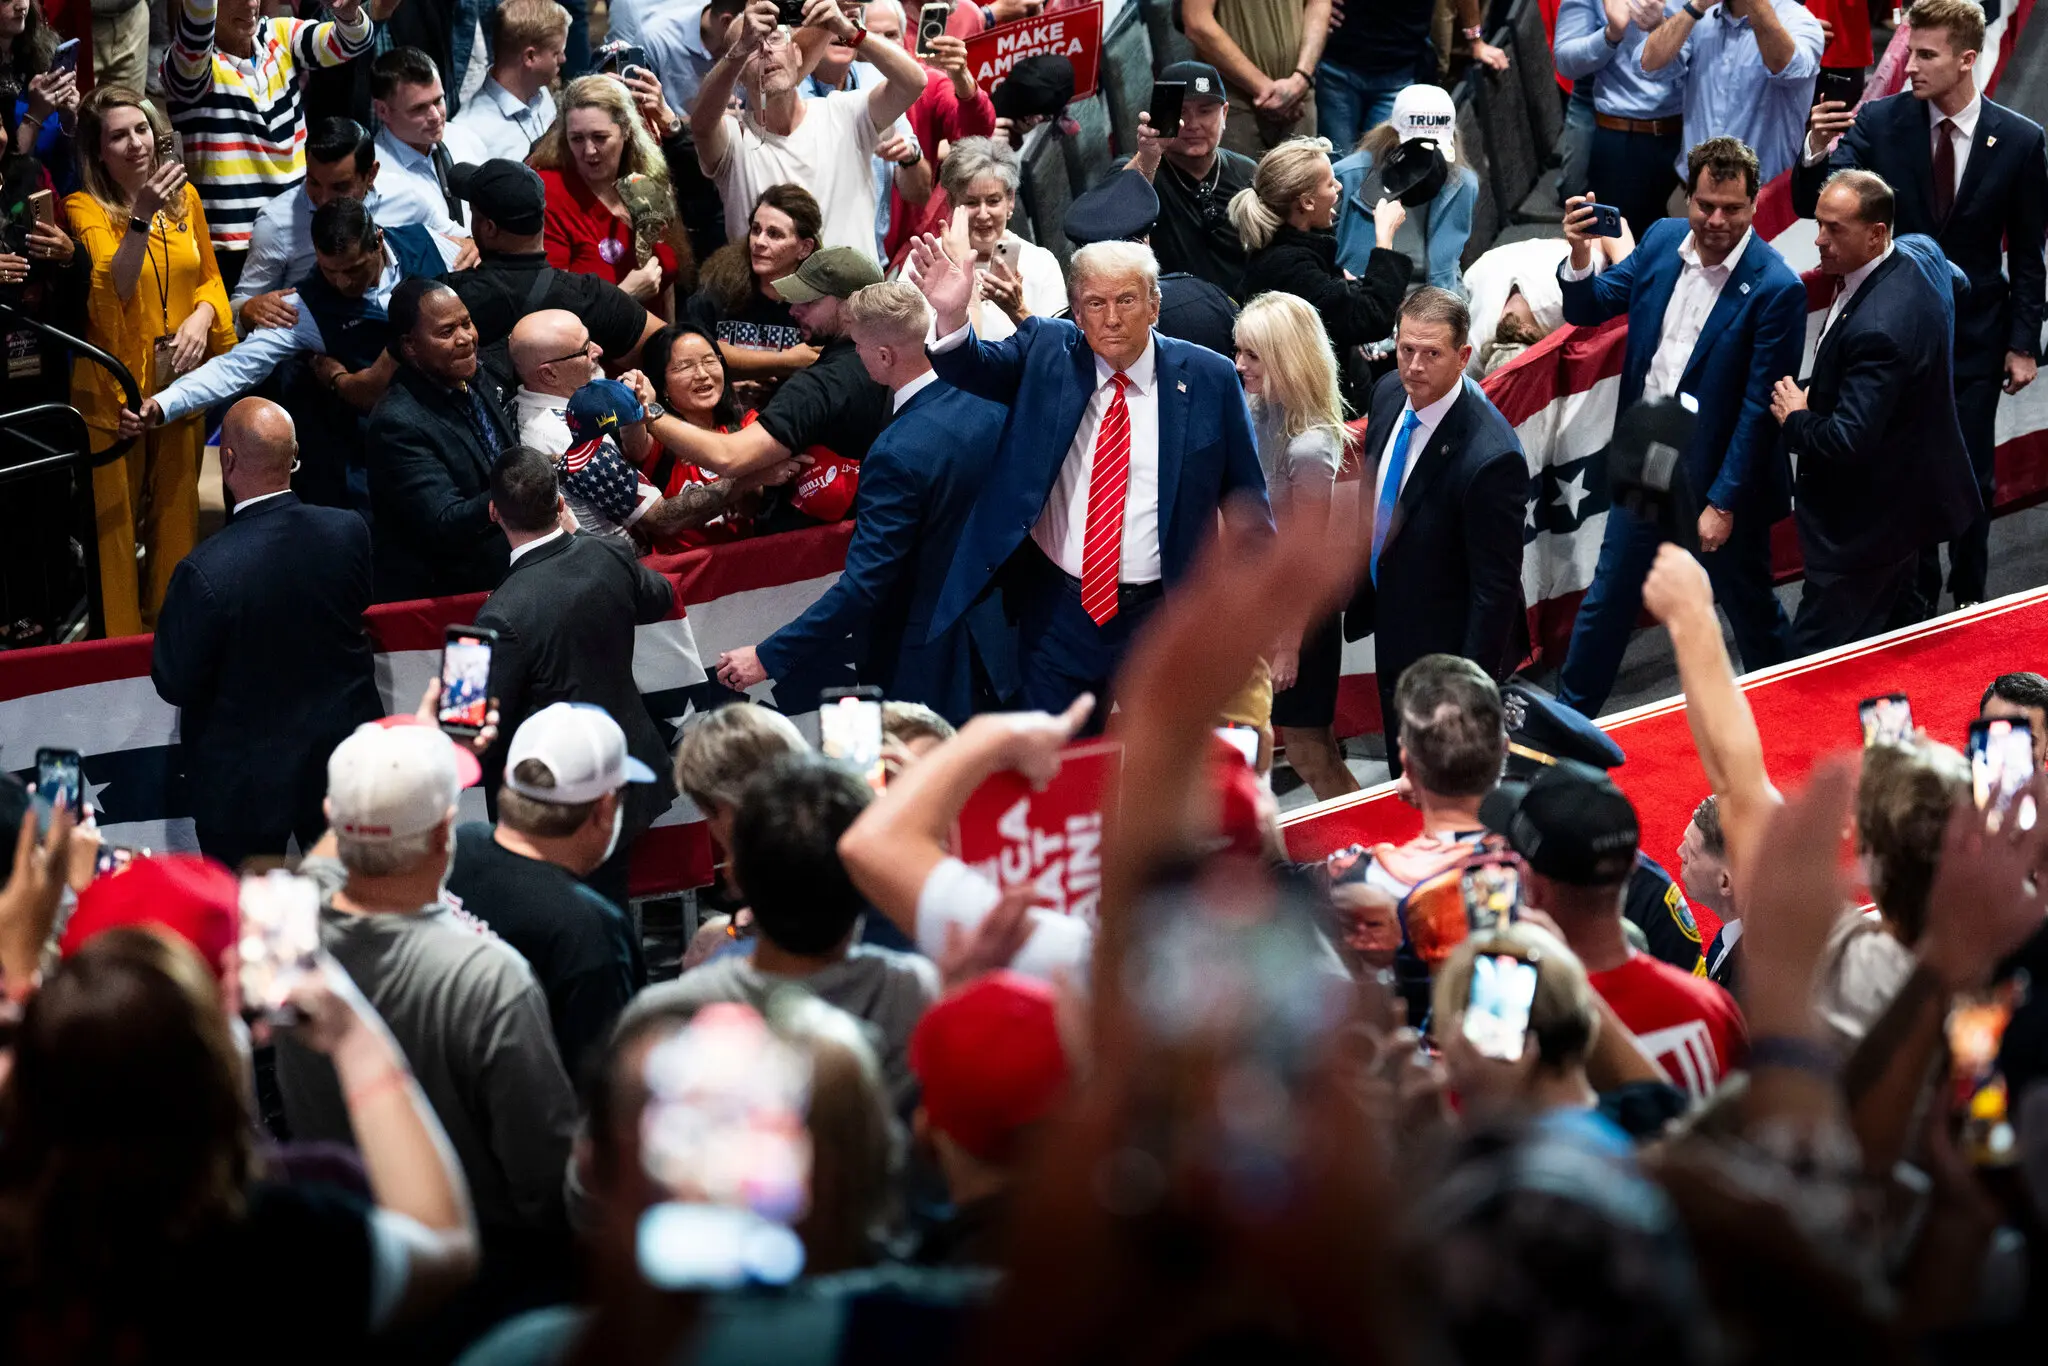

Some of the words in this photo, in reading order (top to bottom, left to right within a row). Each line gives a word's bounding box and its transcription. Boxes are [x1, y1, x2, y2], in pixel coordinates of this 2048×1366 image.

[997, 21, 1064, 55] MAKE
[1409, 114, 1451, 126] TRUMP
[716, 320, 801, 352] TRUM
